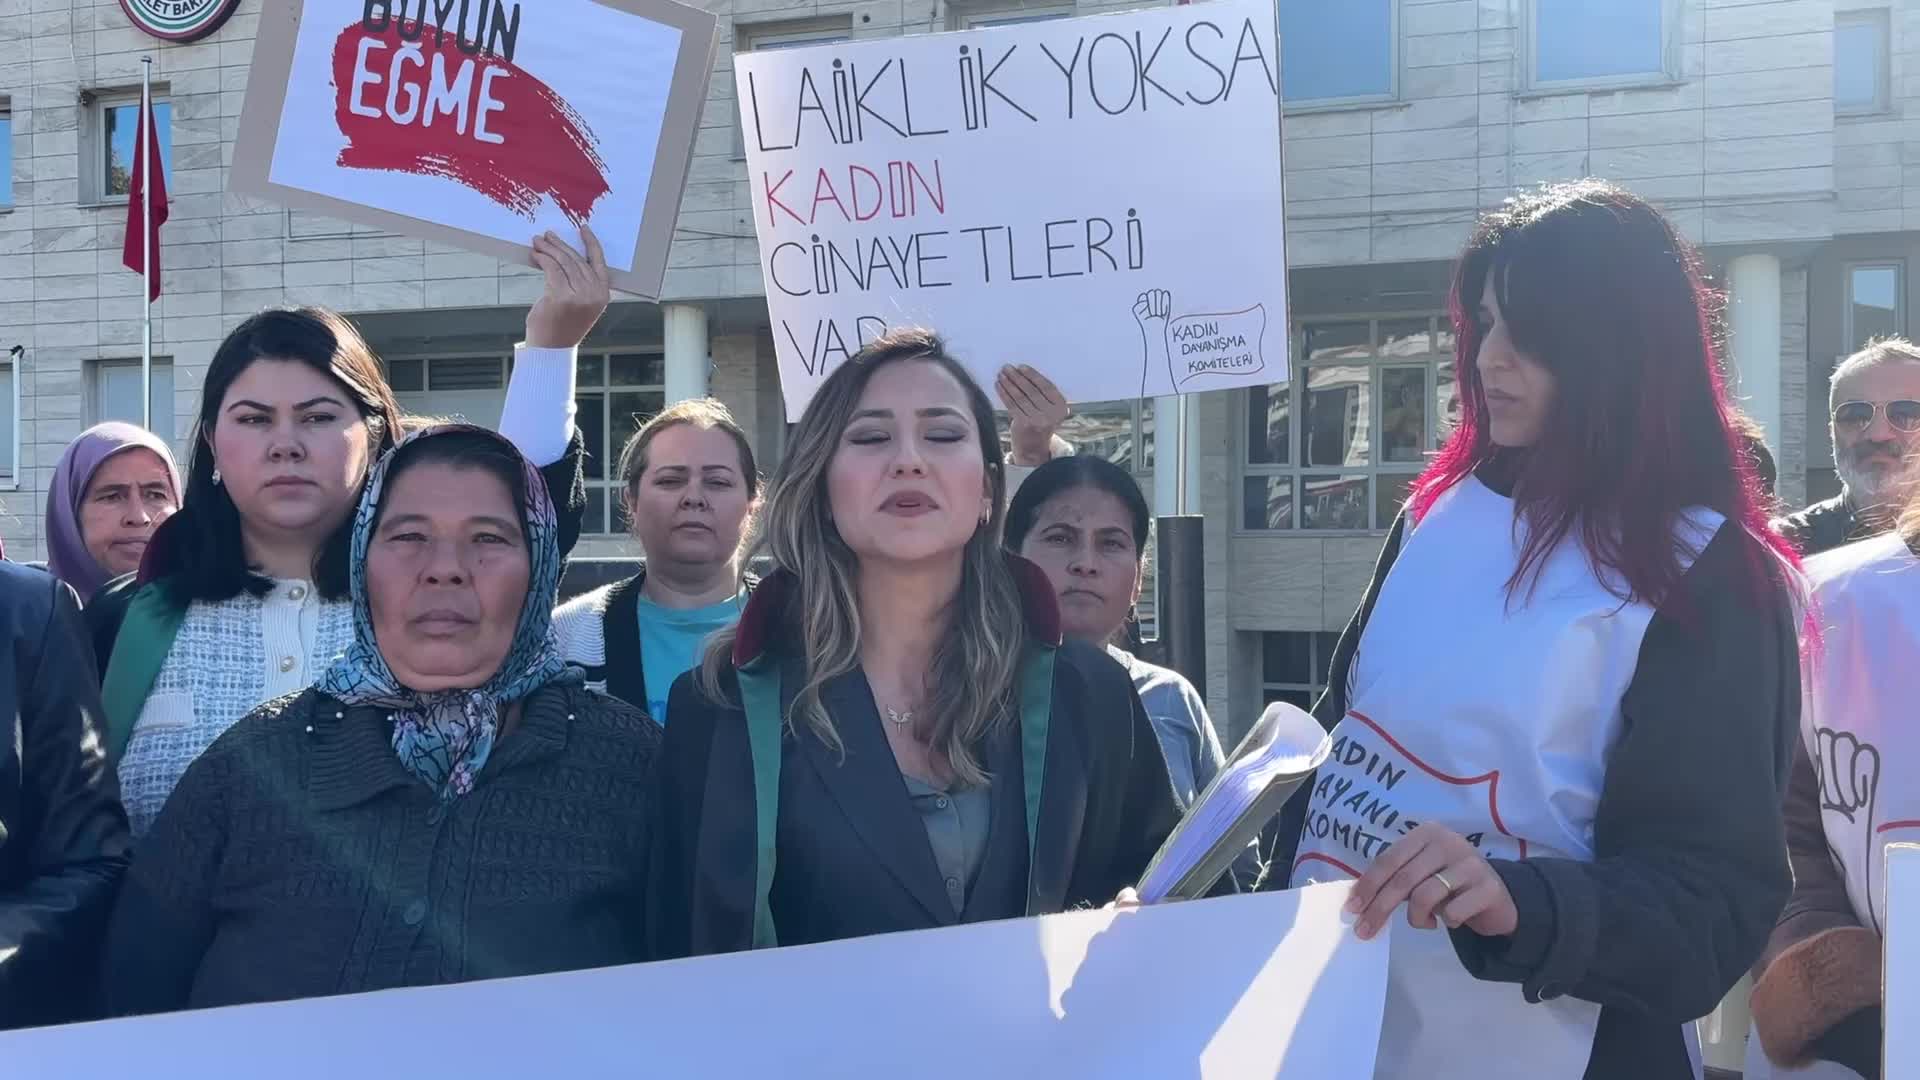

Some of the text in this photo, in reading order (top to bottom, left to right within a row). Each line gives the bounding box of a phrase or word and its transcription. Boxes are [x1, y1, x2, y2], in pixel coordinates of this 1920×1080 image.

[173, 0, 204, 16] BAK
[350, 36, 511, 145] EĞME
[1039, 17, 1278, 119] YOKSA
[764, 159, 945, 227] KADIN
[1172, 321, 1219, 342] KADIN
[1181, 334, 1246, 355] DAYANIŞMA
[1331, 735, 1406, 791] ADIN
